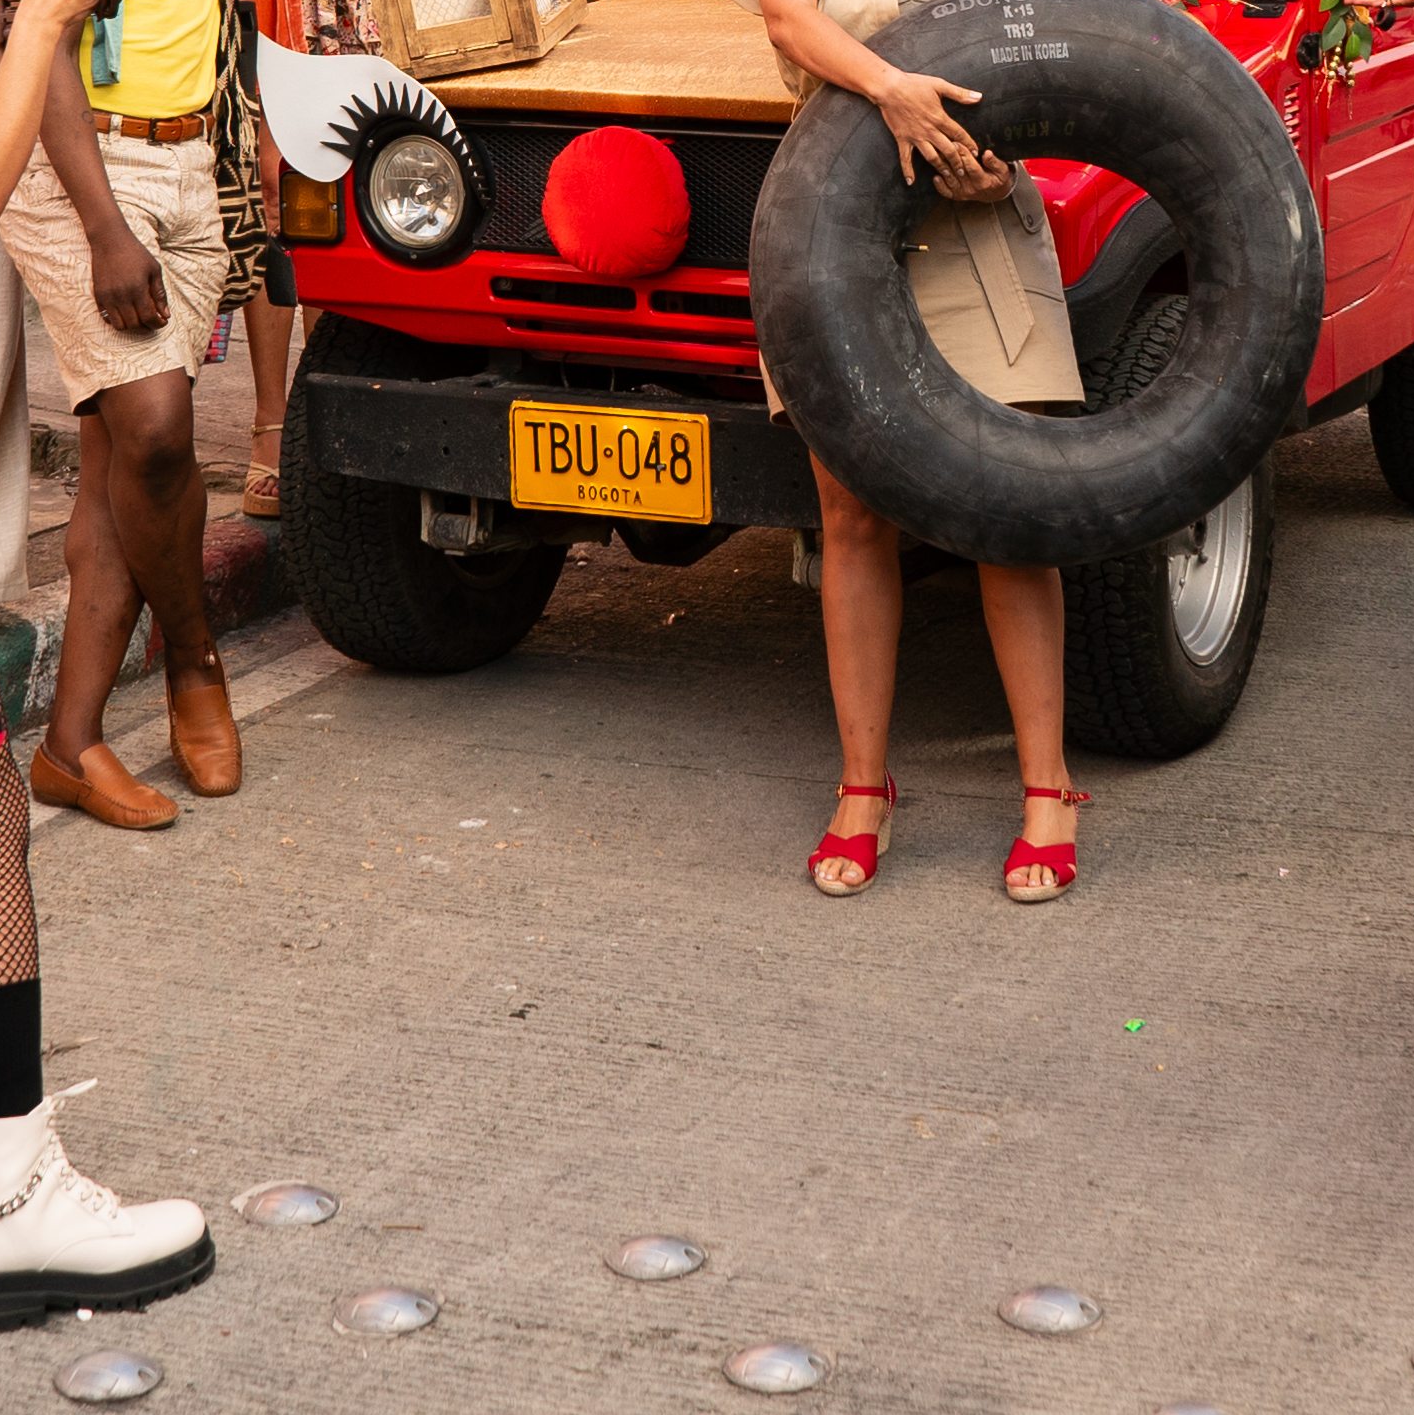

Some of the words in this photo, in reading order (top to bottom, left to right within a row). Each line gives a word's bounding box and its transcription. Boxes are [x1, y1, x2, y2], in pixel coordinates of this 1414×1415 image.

[1003, 22, 1035, 39] TR13
[990, 46, 1020, 64] MADE
[1020, 44, 1033, 61] IN
[1034, 41, 1070, 60] KOREA
[577, 484, 643, 506] BOGOTA
